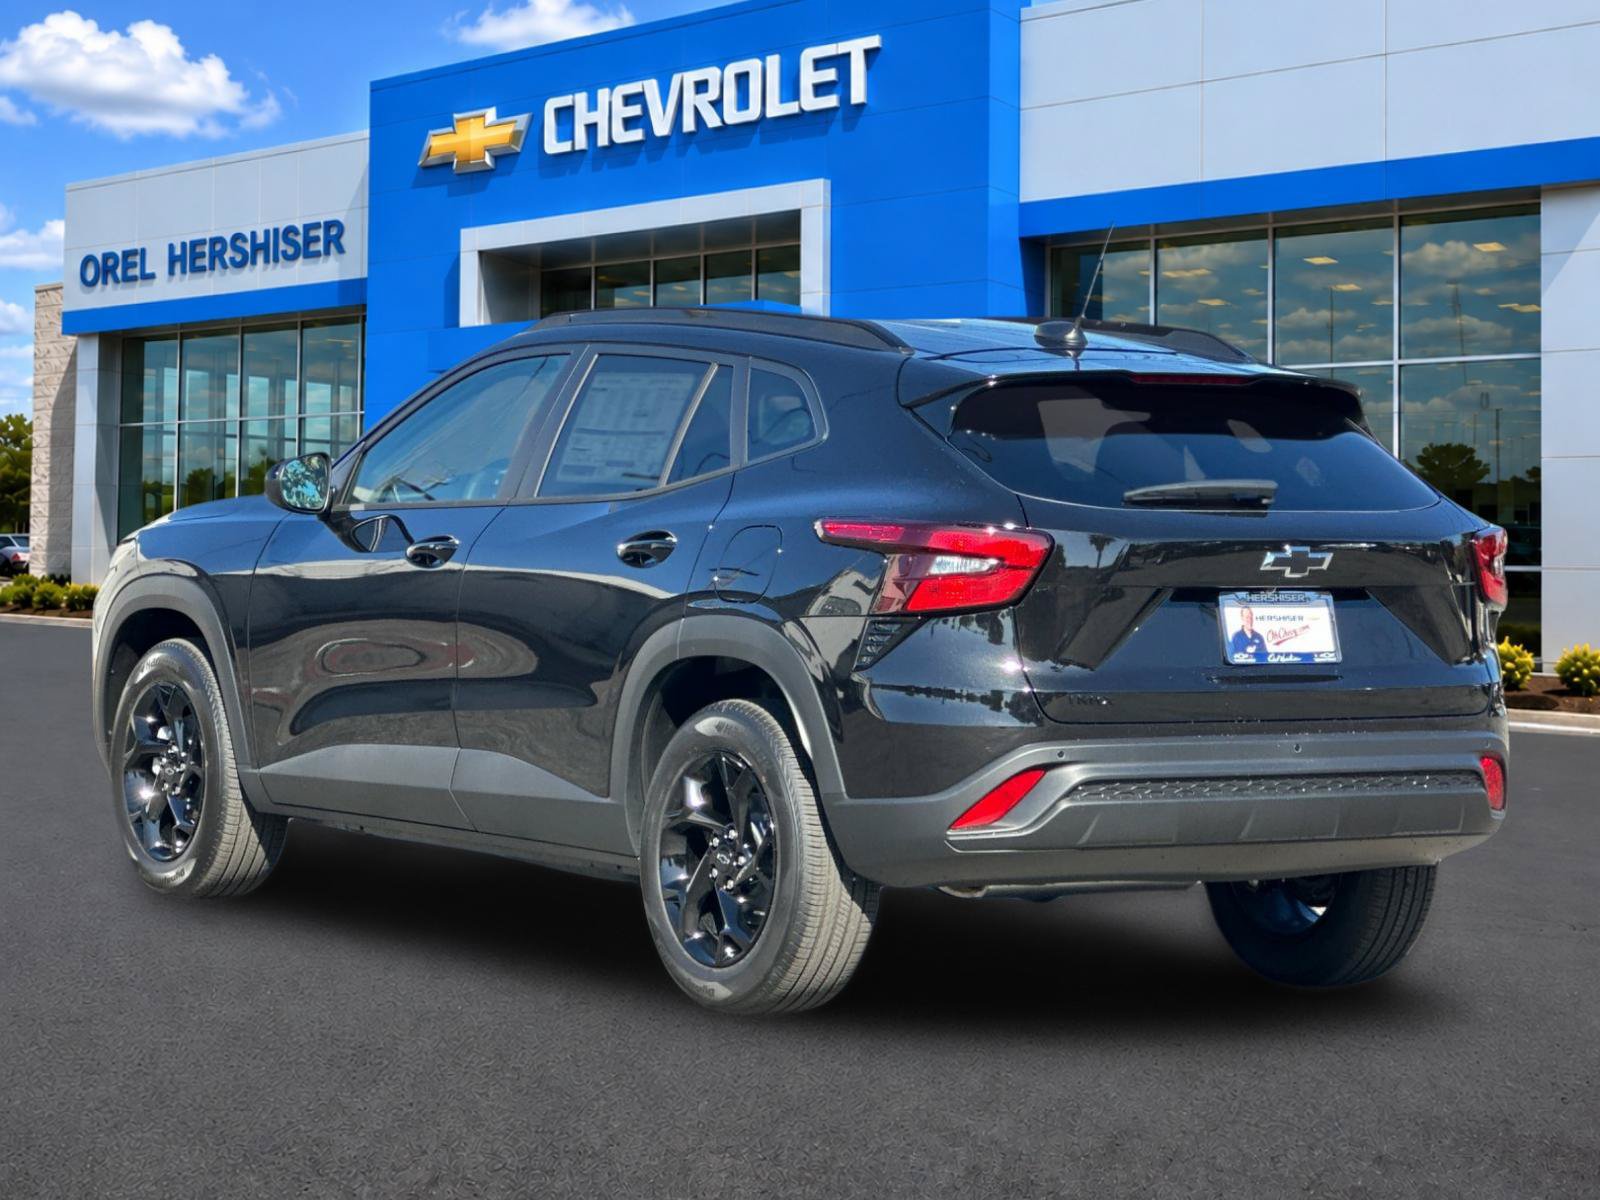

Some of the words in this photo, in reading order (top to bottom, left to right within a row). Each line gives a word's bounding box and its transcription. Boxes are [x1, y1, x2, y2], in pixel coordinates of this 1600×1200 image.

[544, 34, 882, 155] CHEVROLET
[80, 247, 156, 287] OREL
[168, 219, 346, 276] HERSHISER
